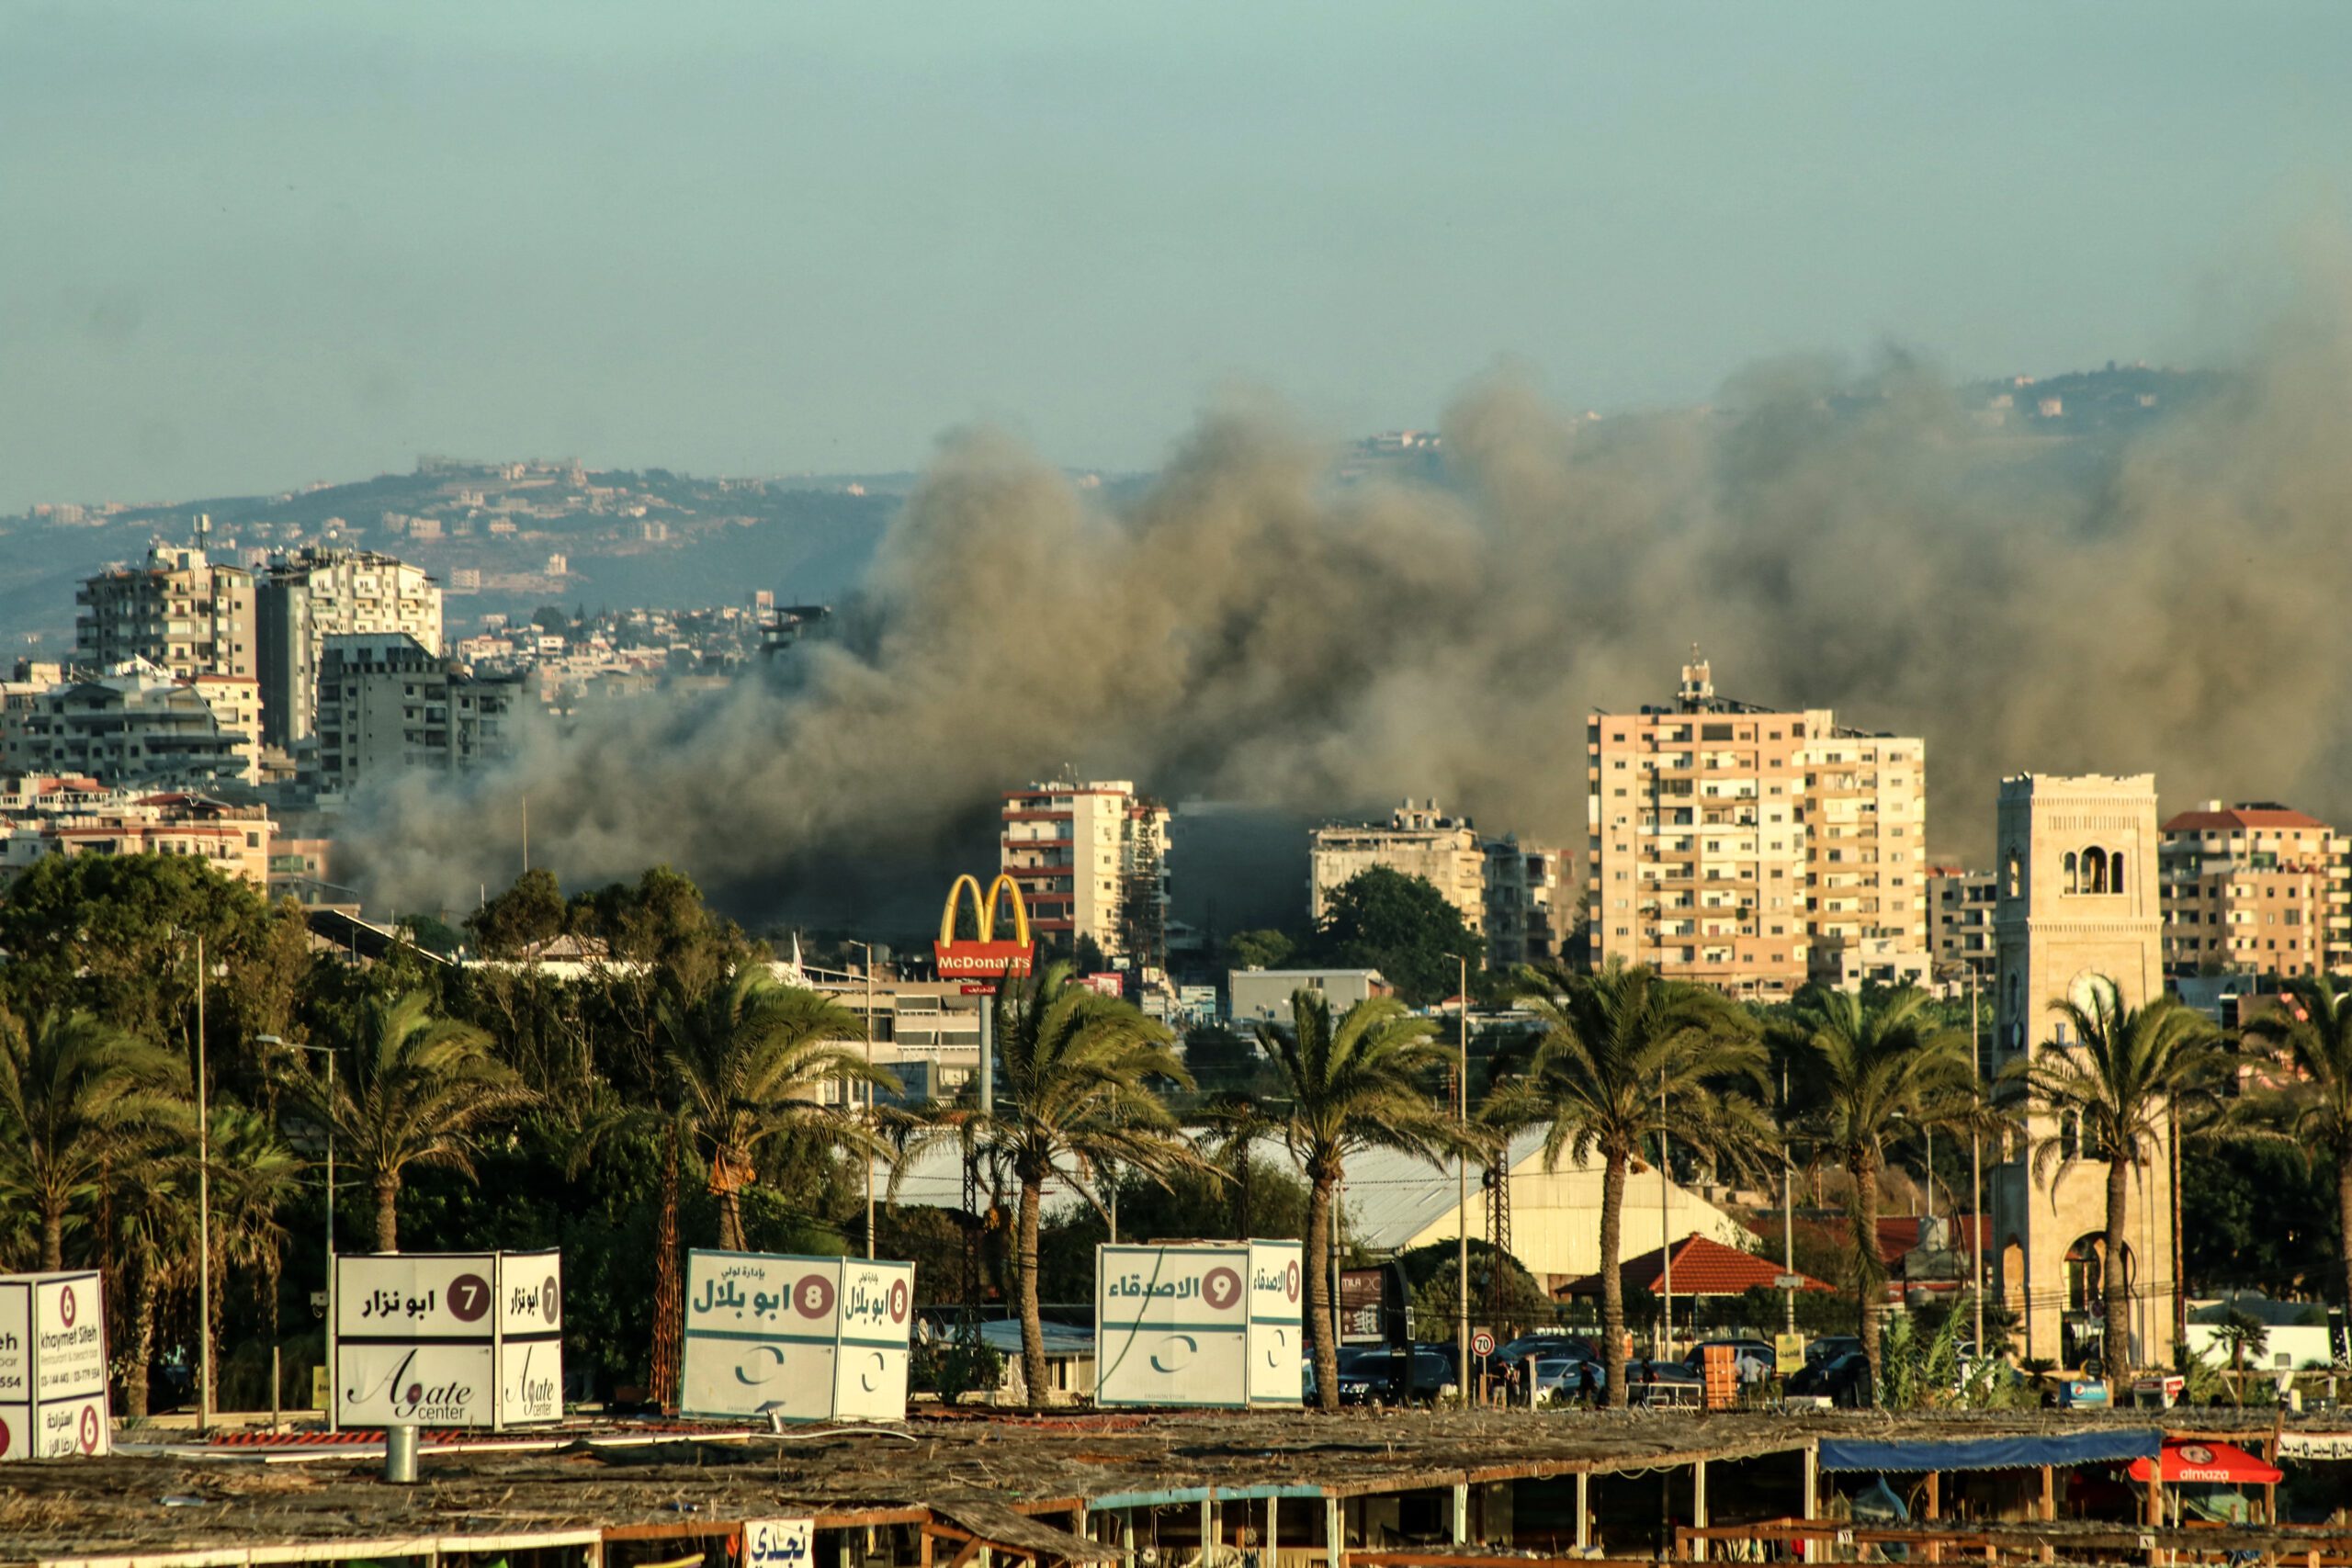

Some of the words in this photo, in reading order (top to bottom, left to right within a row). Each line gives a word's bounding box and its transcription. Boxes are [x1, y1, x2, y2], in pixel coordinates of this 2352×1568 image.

[1109, 1273, 1199, 1299] الاصدقاء
[1212, 1275, 1232, 1302] 9
[1254, 1268, 1286, 1293] الاصدقاء
[1289, 1267, 1296, 1296] 9
[63, 1291, 73, 1320] 6
[362, 1290, 400, 1317] نزار
[406, 1290, 435, 1320] ابو
[461, 1286, 478, 1311] 7
[511, 1287, 526, 1315] نزار
[526, 1286, 538, 1316] ابو
[547, 1288, 554, 1313] 7
[693, 1280, 746, 1319] بلال
[753, 1283, 790, 1320] ابو
[804, 1284, 823, 1310] 8
[845, 1286, 869, 1325] بلال
[872, 1288, 889, 1325] ابو
[894, 1288, 903, 1314] 8
[40, 1329, 78, 1351] khaymet
[1476, 1338, 1489, 1350] 70
[346, 1348, 475, 1418] Agate
[505, 1345, 554, 1416] Agate
[47, 1411, 73, 1432] استراحة
[418, 1404, 465, 1419] center
[533, 1402, 551, 1416] center
[2180, 1468, 2230, 1481] almaza
